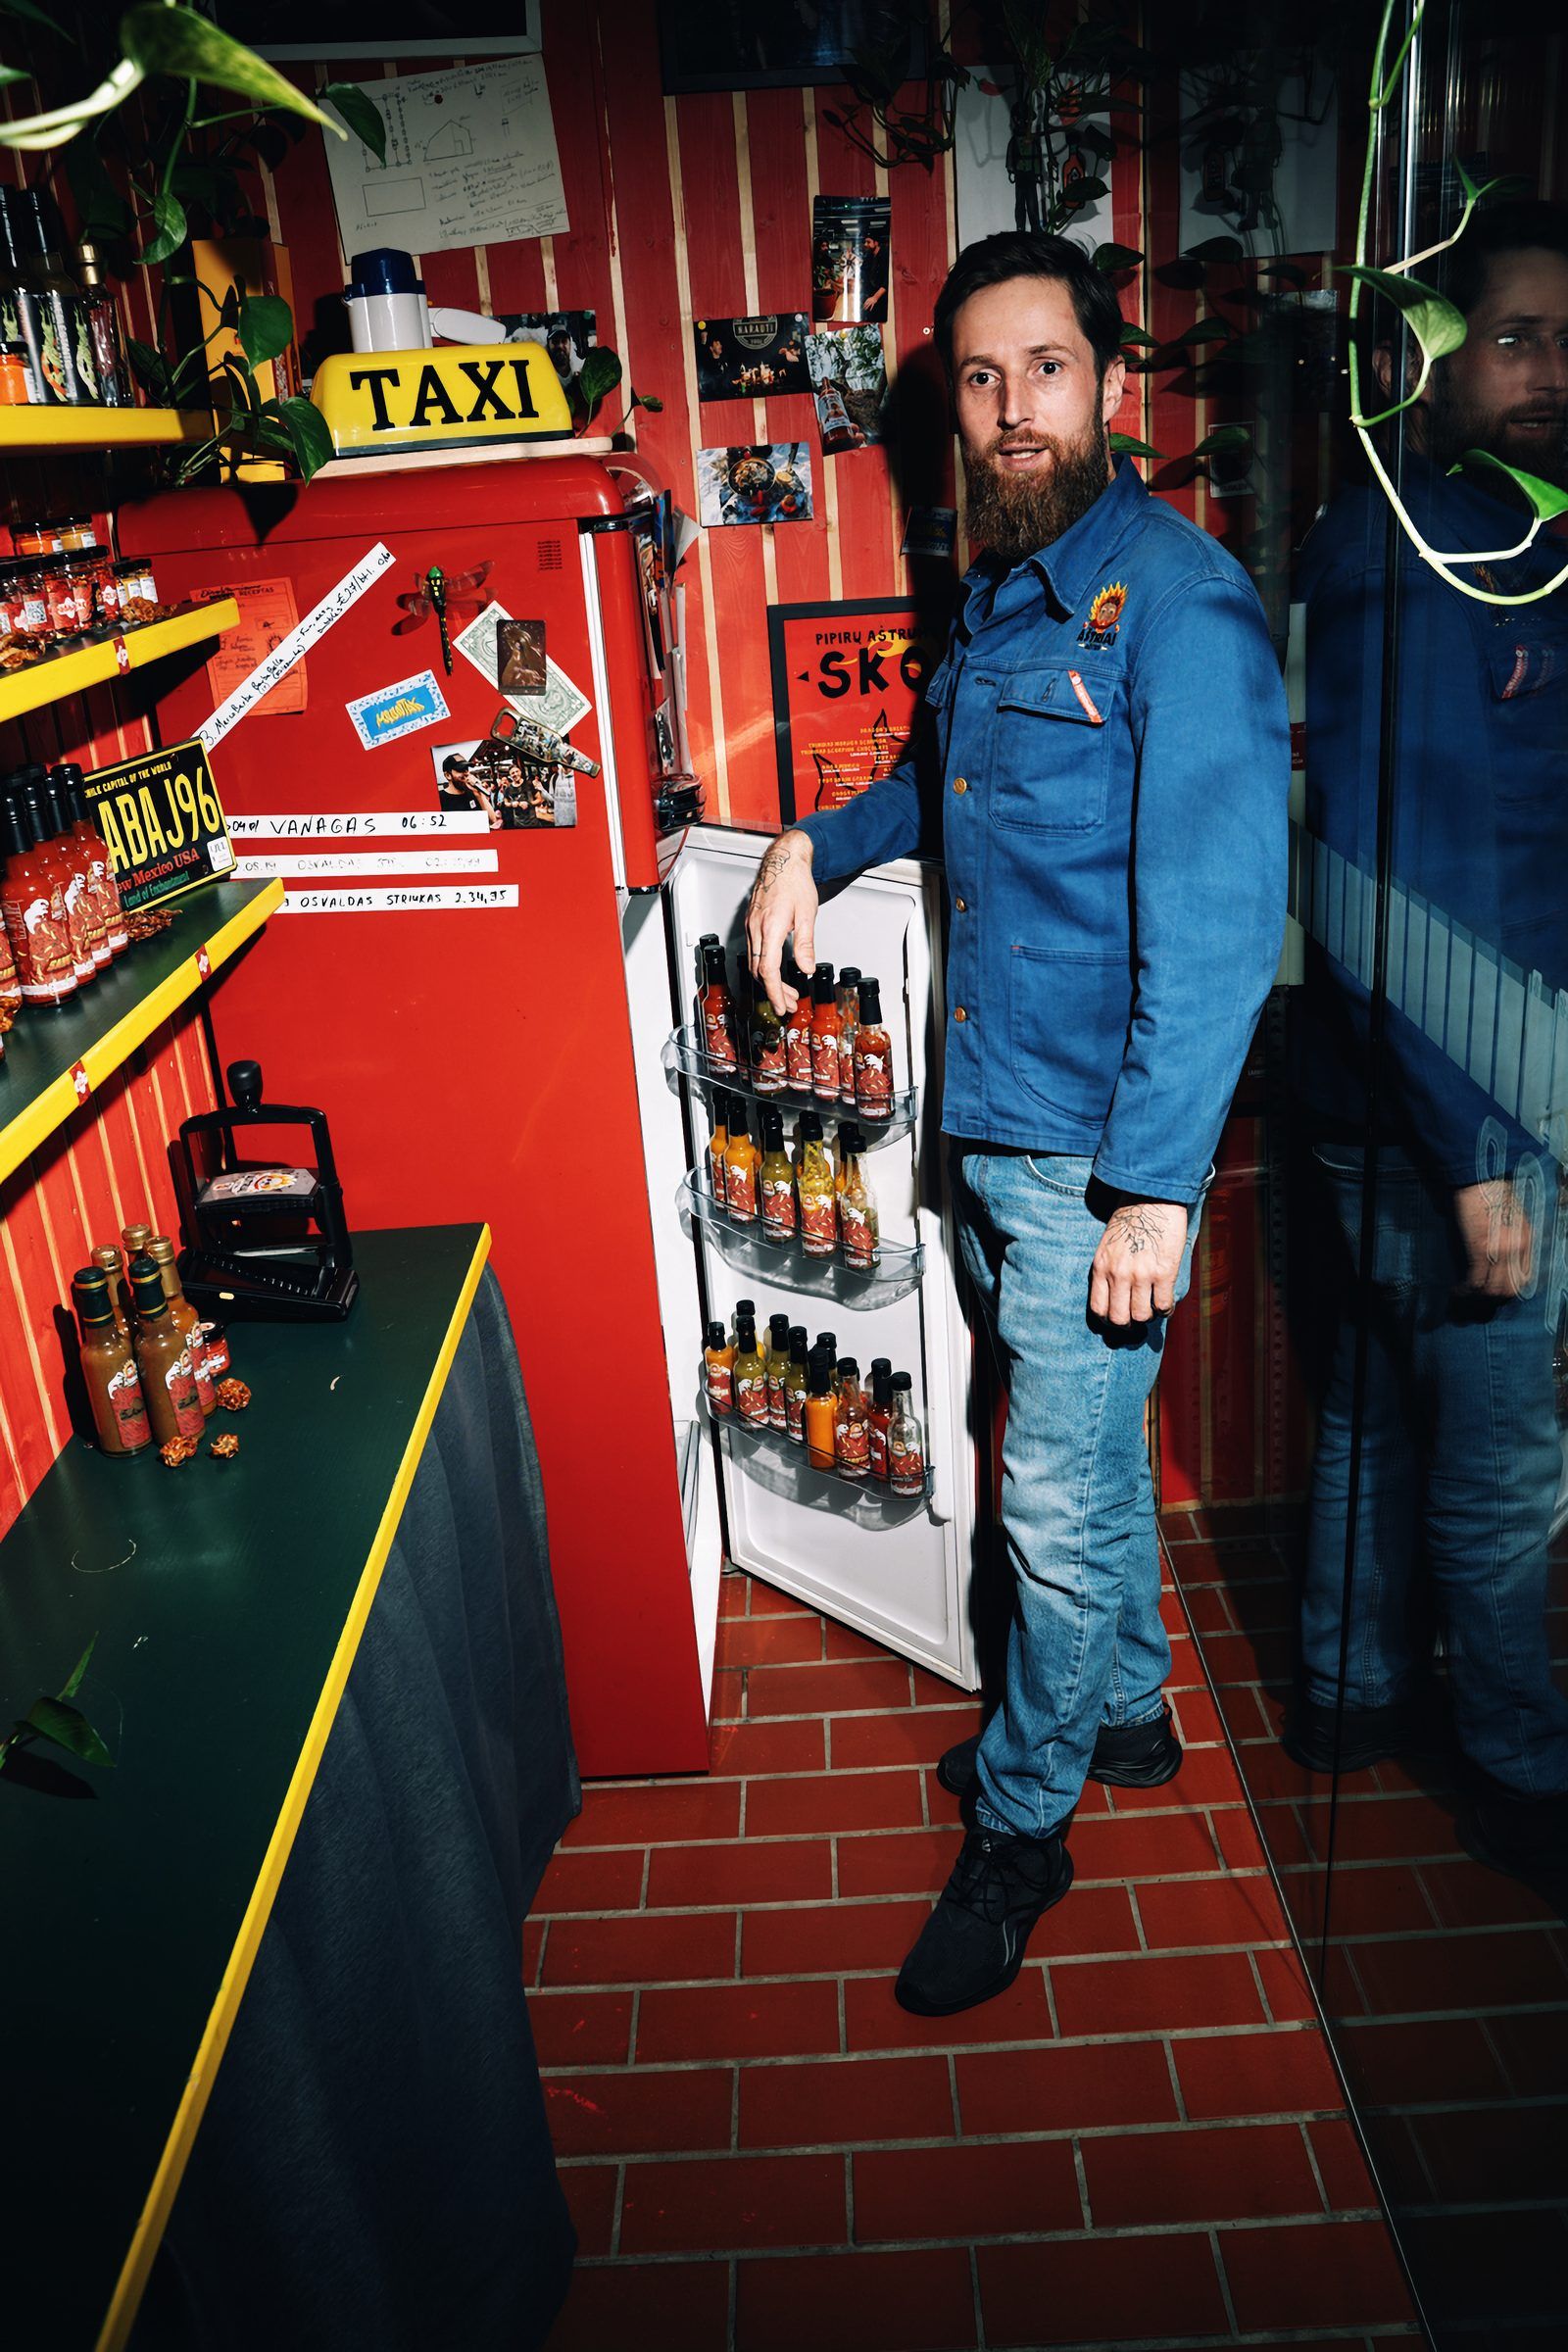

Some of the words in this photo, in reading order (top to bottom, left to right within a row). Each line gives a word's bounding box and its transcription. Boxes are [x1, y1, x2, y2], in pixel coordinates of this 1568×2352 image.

[350, 359, 540, 431] TAXI
[815, 630, 862, 646] PIPIRŲ
[867, 625, 919, 643] AŠTRU
[102, 776, 129, 793] CAPITAL
[128, 772, 137, 784] OF
[137, 767, 151, 780] THE
[150, 760, 172, 775] WORLD
[98, 765, 220, 873] ABAJ96
[270, 815, 376, 836] VANAGAS
[402, 814, 448, 829] 06:52
[116, 878, 132, 894] ew
[131, 860, 174, 887] Mexico
[172, 848, 201, 868] USA
[141, 885, 150, 901] of
[300, 895, 373, 908] OSVALDAS
